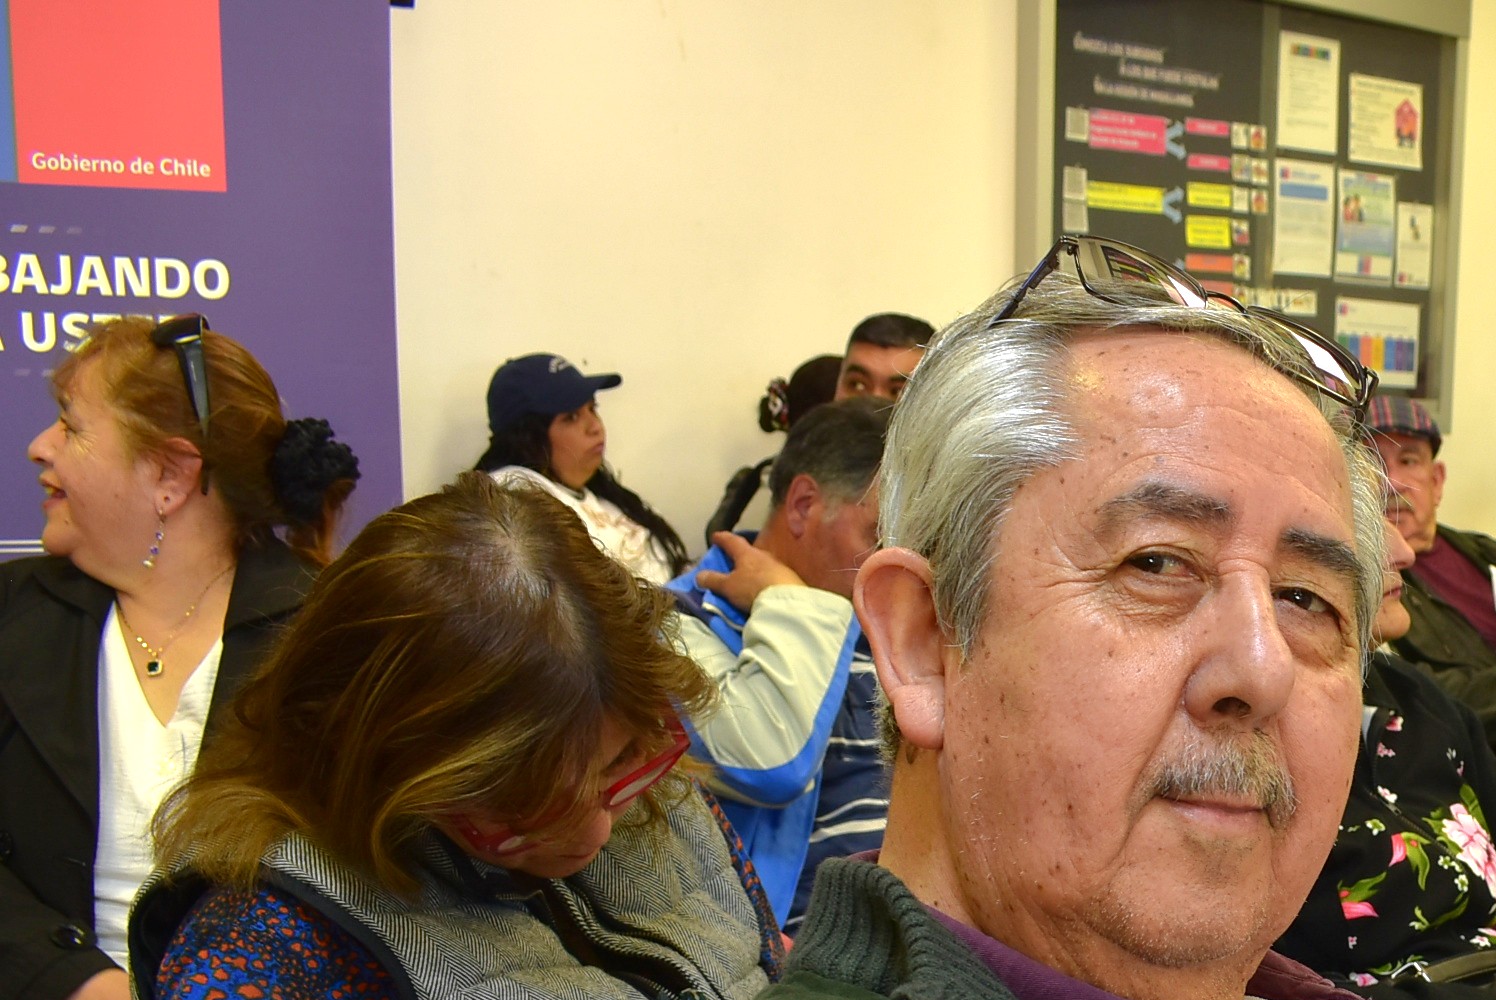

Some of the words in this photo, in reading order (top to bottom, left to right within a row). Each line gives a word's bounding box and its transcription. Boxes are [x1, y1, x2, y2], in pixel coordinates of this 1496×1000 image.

[31, 152, 125, 174] Gobierno
[130, 157, 155, 176] de
[160, 158, 211, 178] Chile
